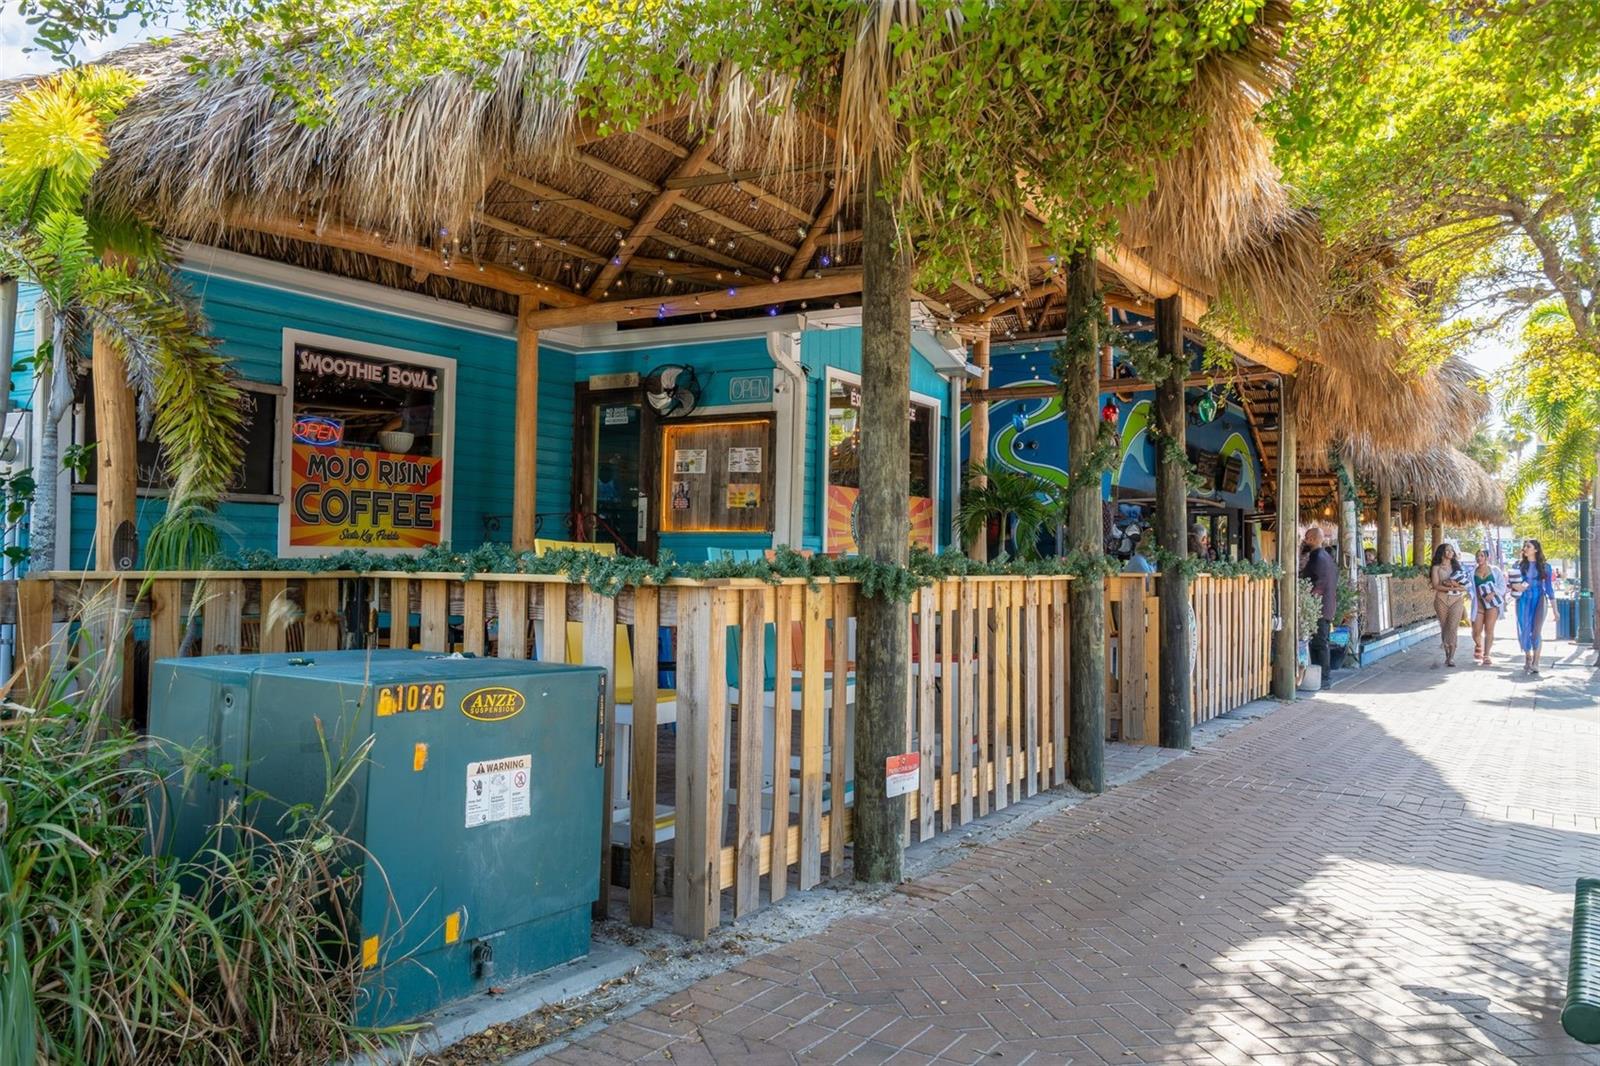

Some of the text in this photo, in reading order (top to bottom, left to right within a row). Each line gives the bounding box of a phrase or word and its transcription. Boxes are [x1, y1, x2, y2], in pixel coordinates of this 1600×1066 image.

[300, 351, 438, 390] SMOOTHIE BOWLS
[732, 378, 769, 399] OPEN
[292, 422, 343, 441] OPEN
[307, 453, 432, 488] MOJO RISIN'
[294, 482, 434, 528] COFFEE
[469, 706, 515, 714] SUSPENSION
[470, 693, 518, 708] ANZE
[486, 760, 524, 773] WARNING
